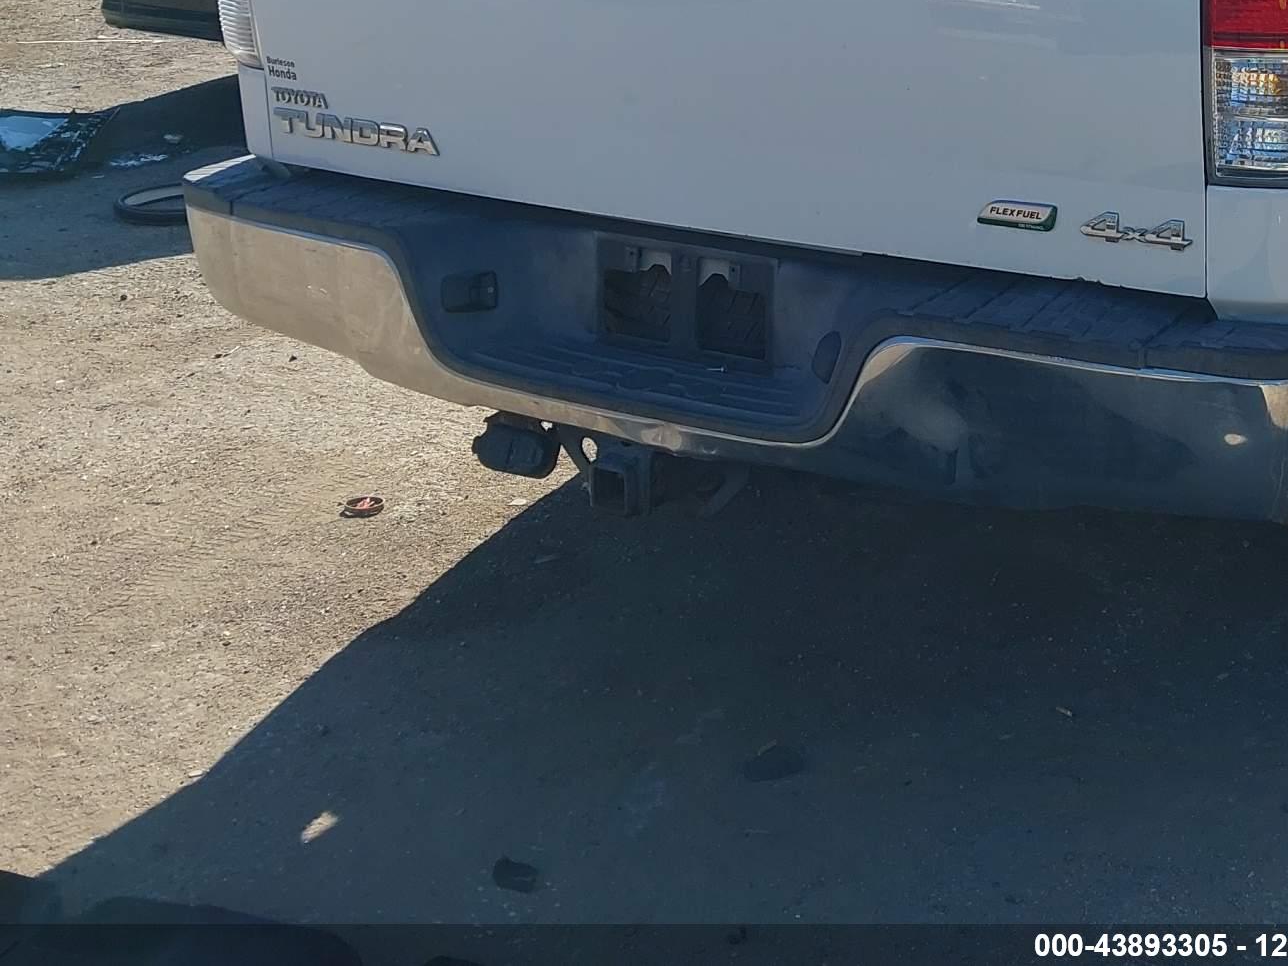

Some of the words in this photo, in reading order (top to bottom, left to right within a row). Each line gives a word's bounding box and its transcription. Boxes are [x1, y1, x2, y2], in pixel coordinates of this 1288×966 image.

[268, 65, 297, 81] Honda
[271, 87, 328, 109] TOYOTA
[273, 107, 440, 156] TUNDRA
[1079, 210, 1193, 251] 4x4
